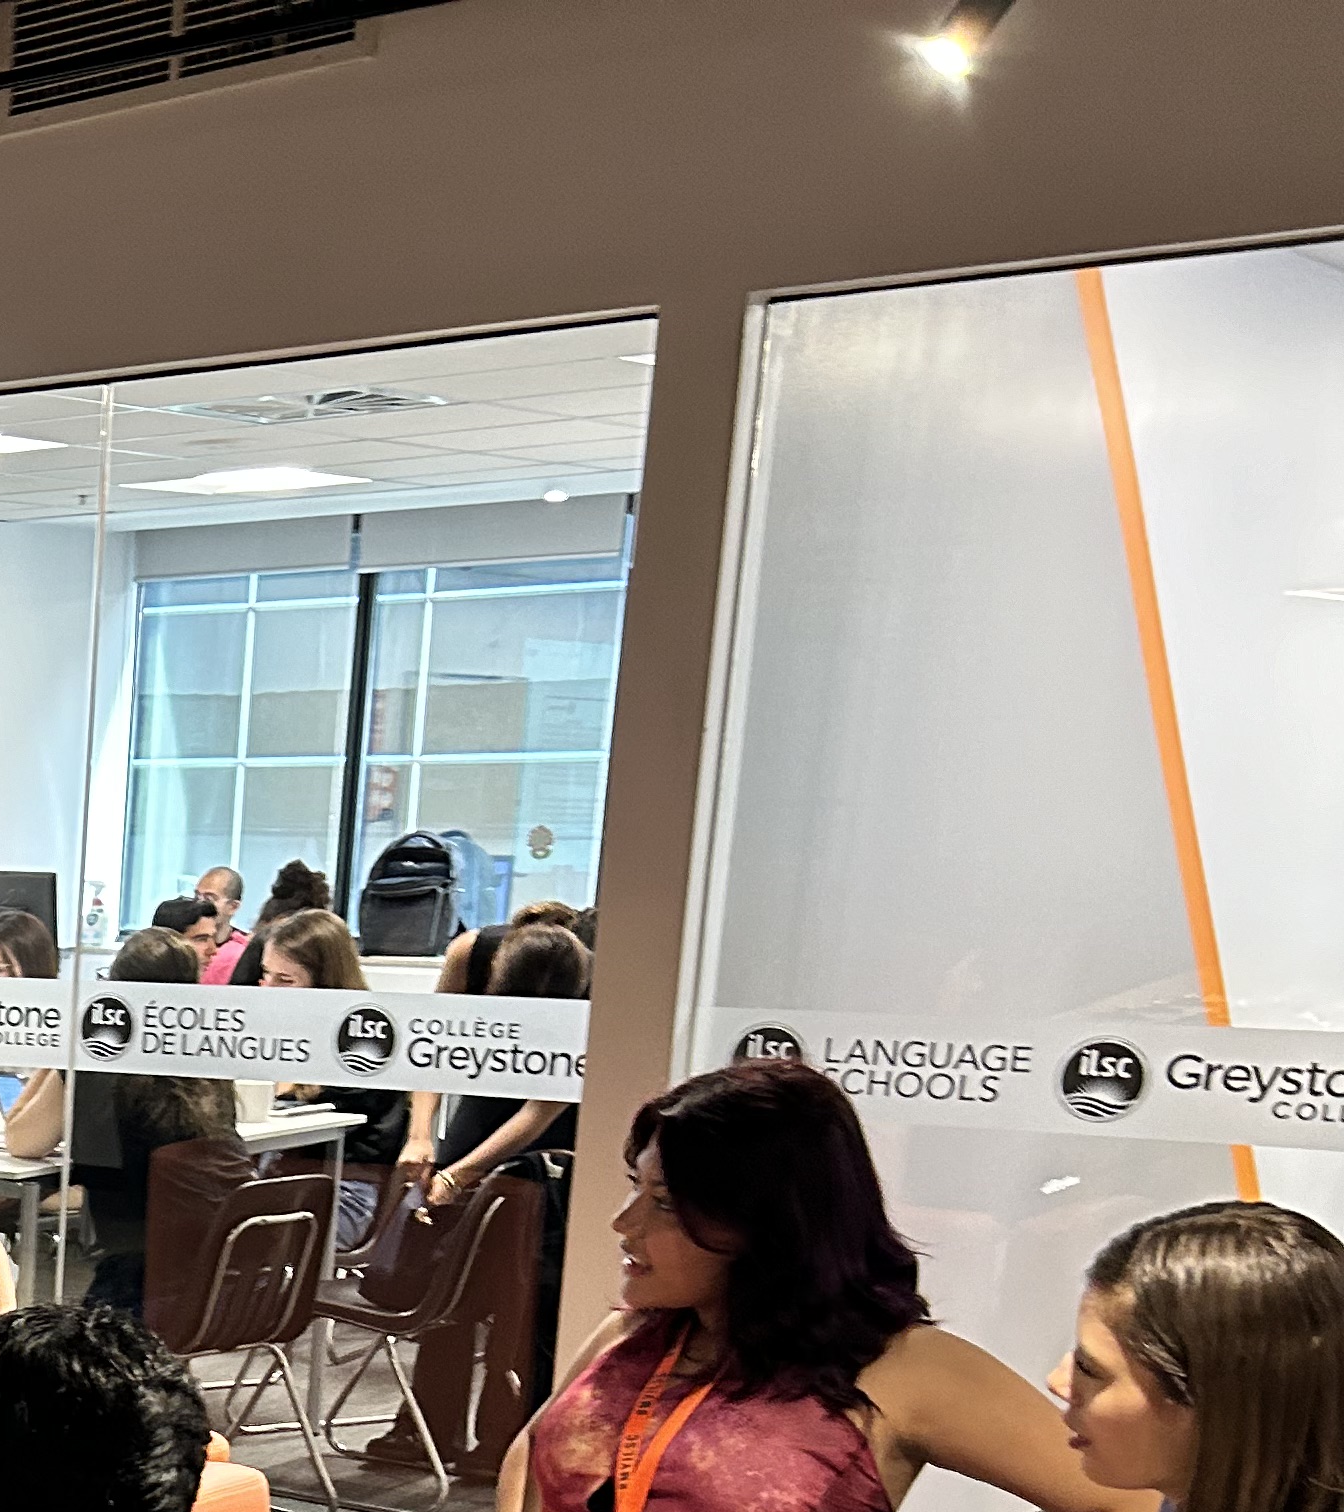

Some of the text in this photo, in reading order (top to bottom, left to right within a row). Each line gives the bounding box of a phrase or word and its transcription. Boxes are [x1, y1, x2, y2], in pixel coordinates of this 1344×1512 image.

[91, 1001, 126, 1027] ilsc
[143, 1001, 246, 1032] ÉCOLES
[348, 1013, 388, 1040] ilsc
[409, 1017, 521, 1040] COLLÈGE
[142, 1032, 311, 1063] DE LANGUES
[823, 1037, 1033, 1075] LANGUAGE
[1080, 1049, 1135, 1081] ilsc
[823, 1067, 1000, 1103] CHOOLS
